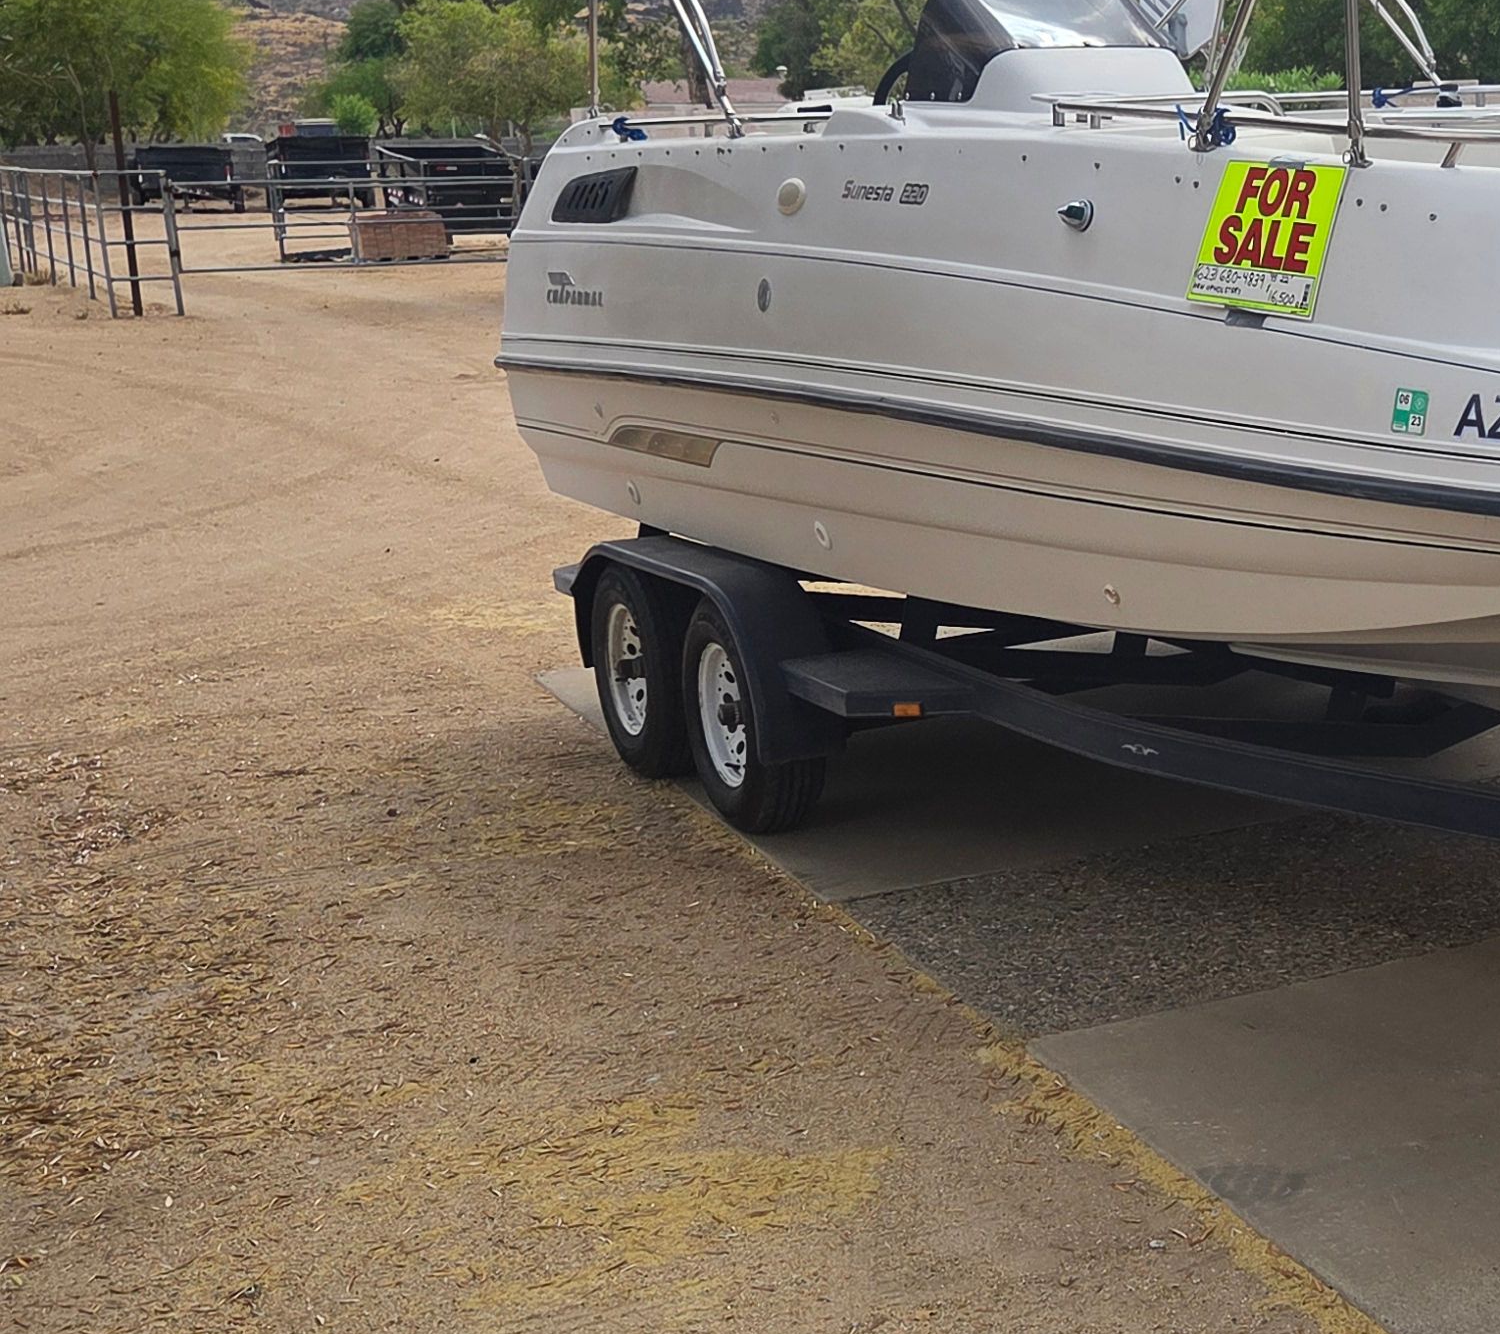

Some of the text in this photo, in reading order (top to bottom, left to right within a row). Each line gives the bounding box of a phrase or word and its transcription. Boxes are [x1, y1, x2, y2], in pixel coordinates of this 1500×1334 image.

[842, 180, 930, 205] Sunesta 220
[1235, 167, 1317, 219] FOR
[1214, 215, 1317, 273] SALE
[1399, 393, 1411, 405] 06
[1410, 415, 1422, 427] 23
